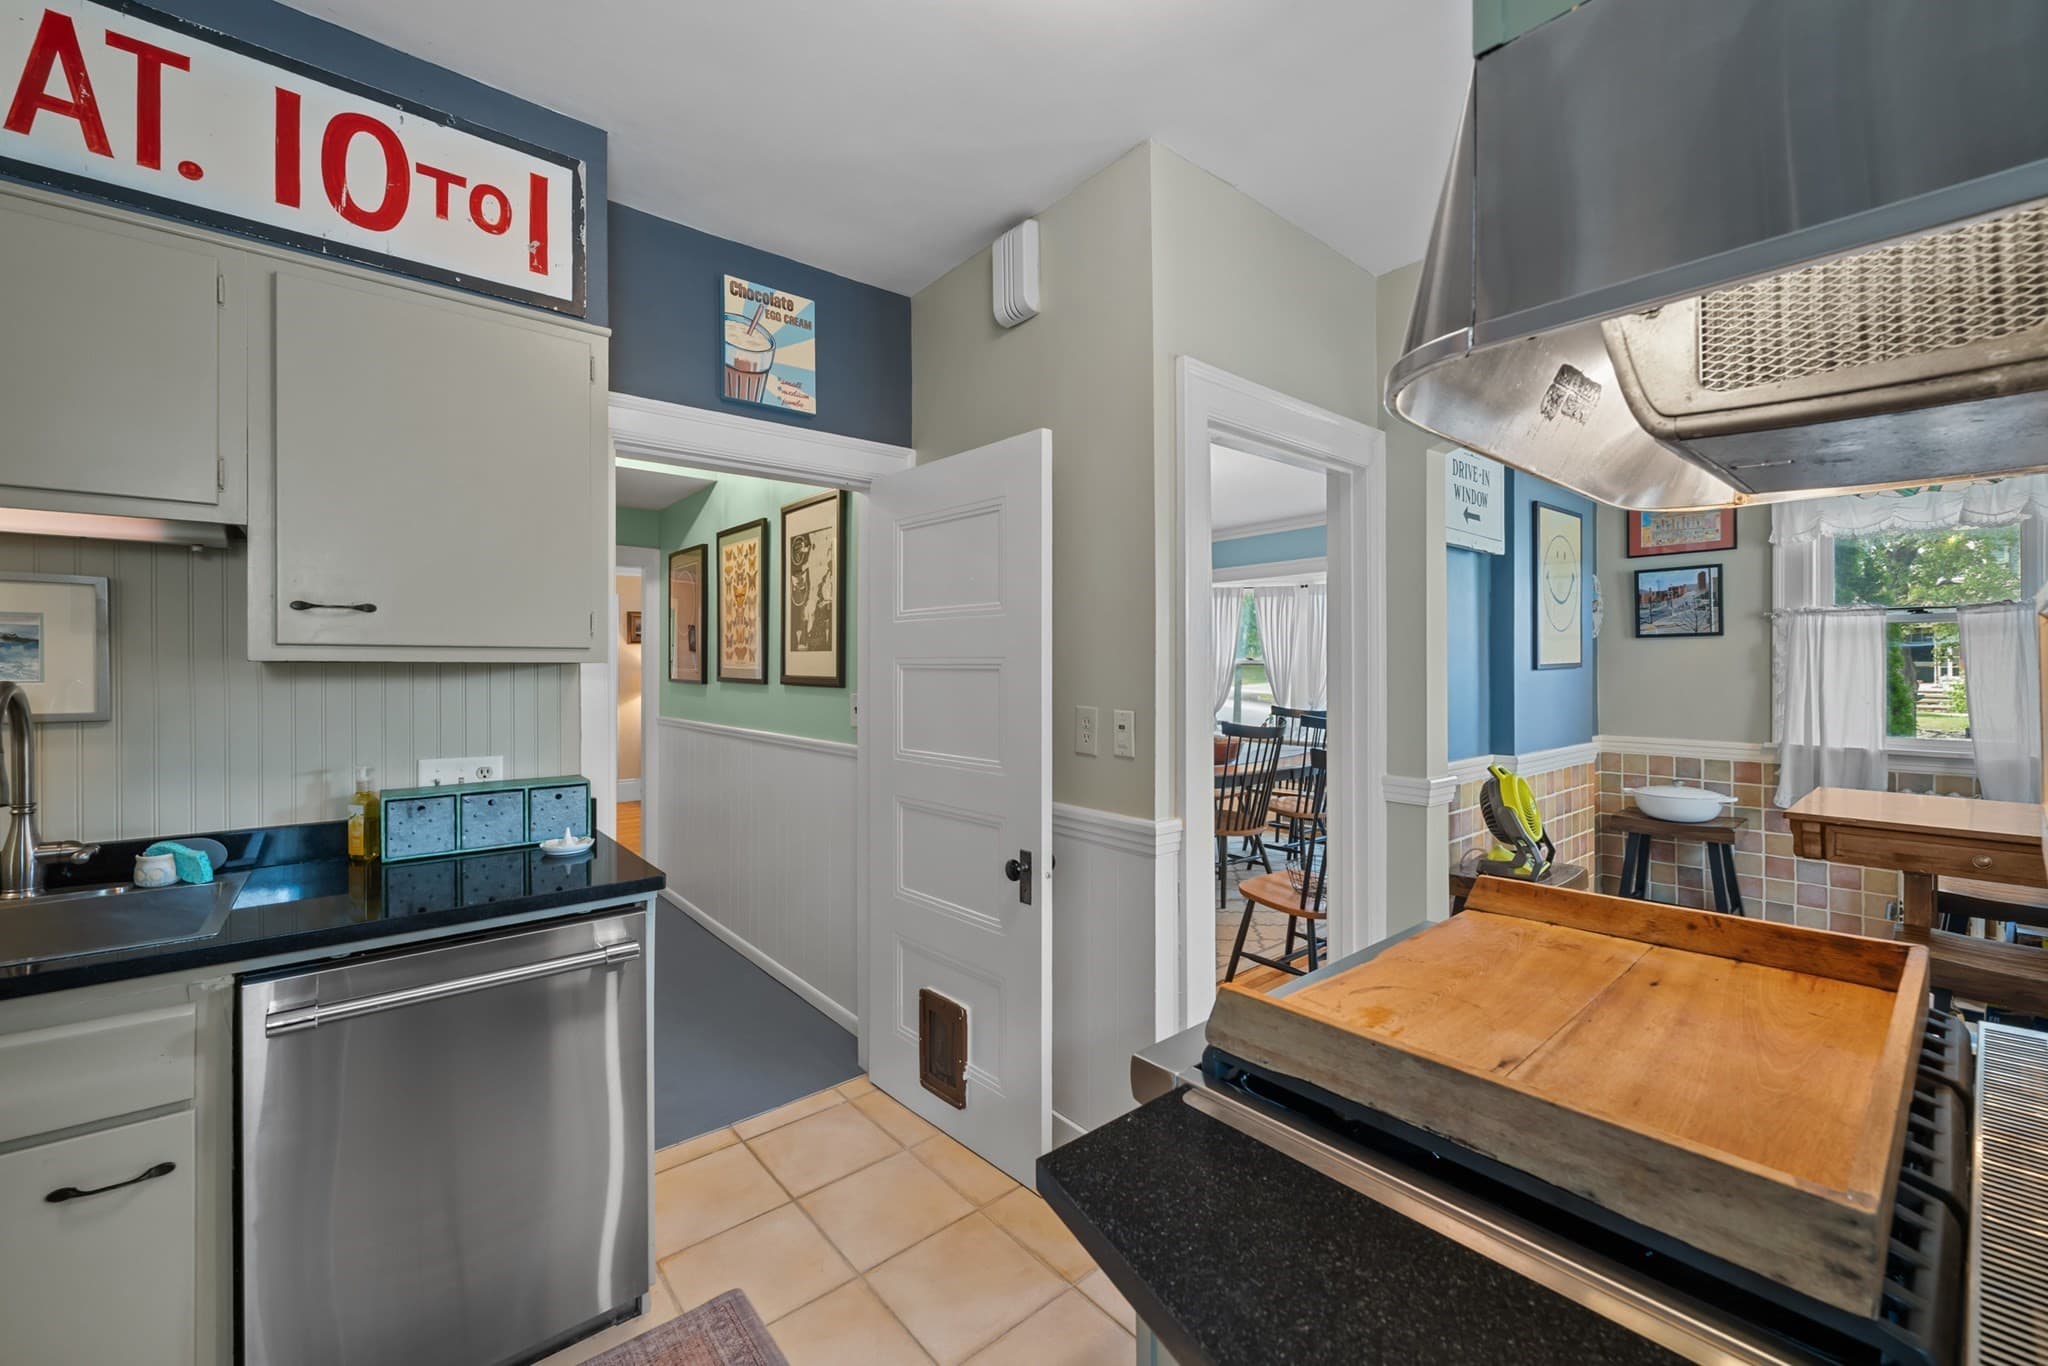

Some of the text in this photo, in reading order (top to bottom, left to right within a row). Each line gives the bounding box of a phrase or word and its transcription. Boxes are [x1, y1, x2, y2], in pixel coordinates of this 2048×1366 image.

[4, 9, 204, 181] AT.
[275, 87, 411, 232] 10
[415, 163, 513, 235] TO
[730, 280, 794, 311] Chocolate
[765, 309, 812, 330] EGG CREAM
[1454, 483, 1488, 508] WINDOW
